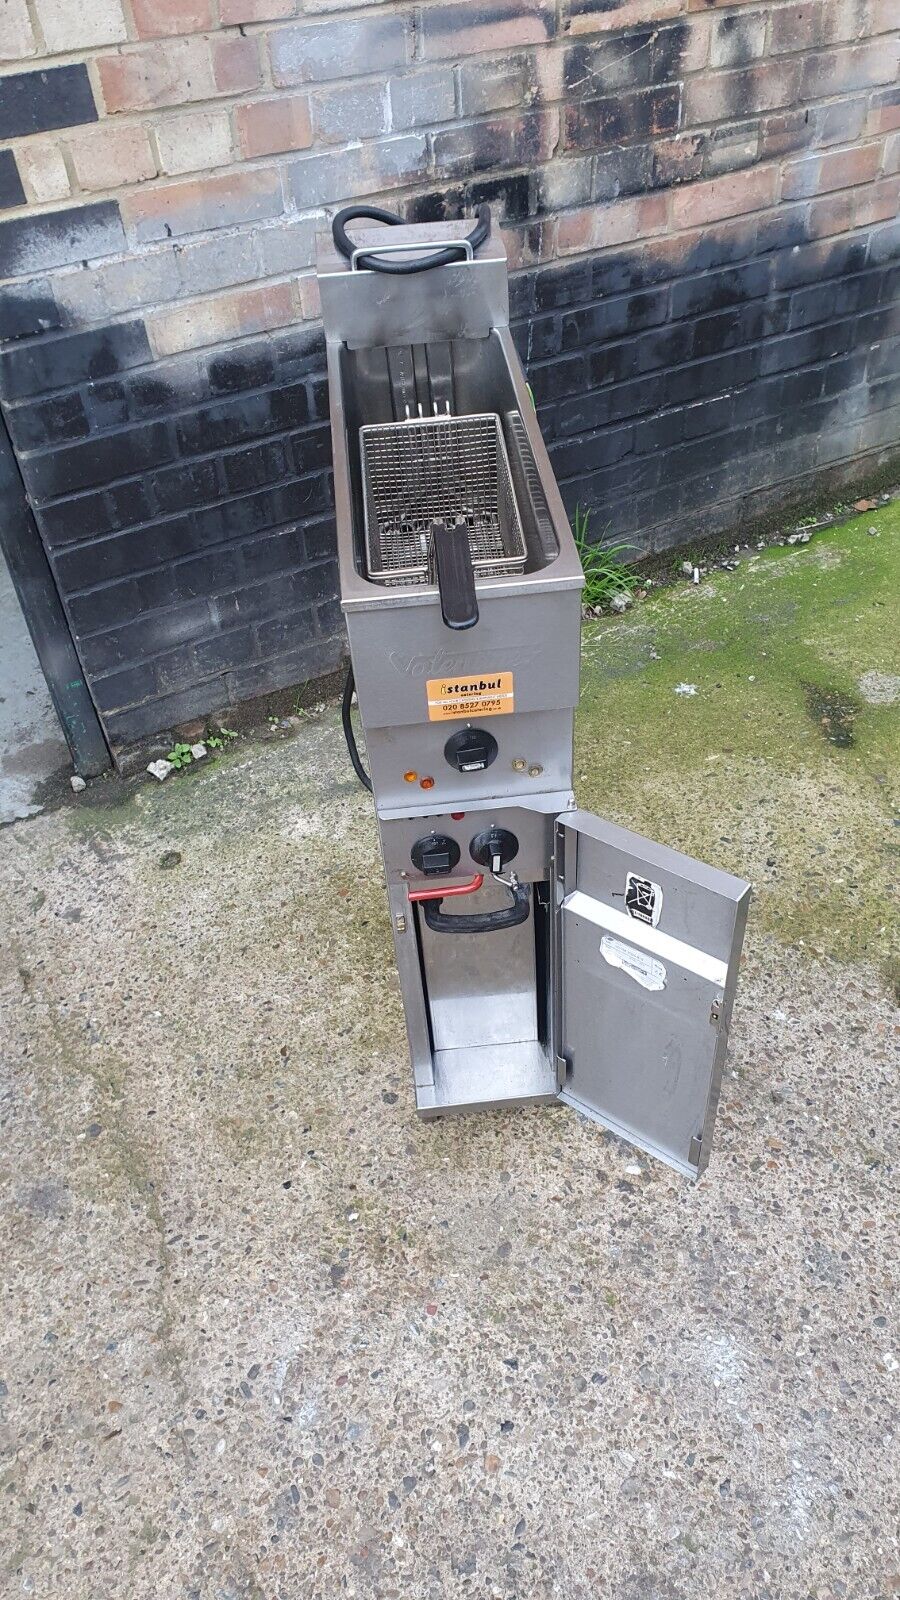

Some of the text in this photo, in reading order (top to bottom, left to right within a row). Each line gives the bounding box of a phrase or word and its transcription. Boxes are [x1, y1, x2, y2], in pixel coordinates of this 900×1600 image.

[440, 678, 502, 695] istanbul
[460, 701, 479, 710] 8527
[481, 699, 501, 707] 0795
